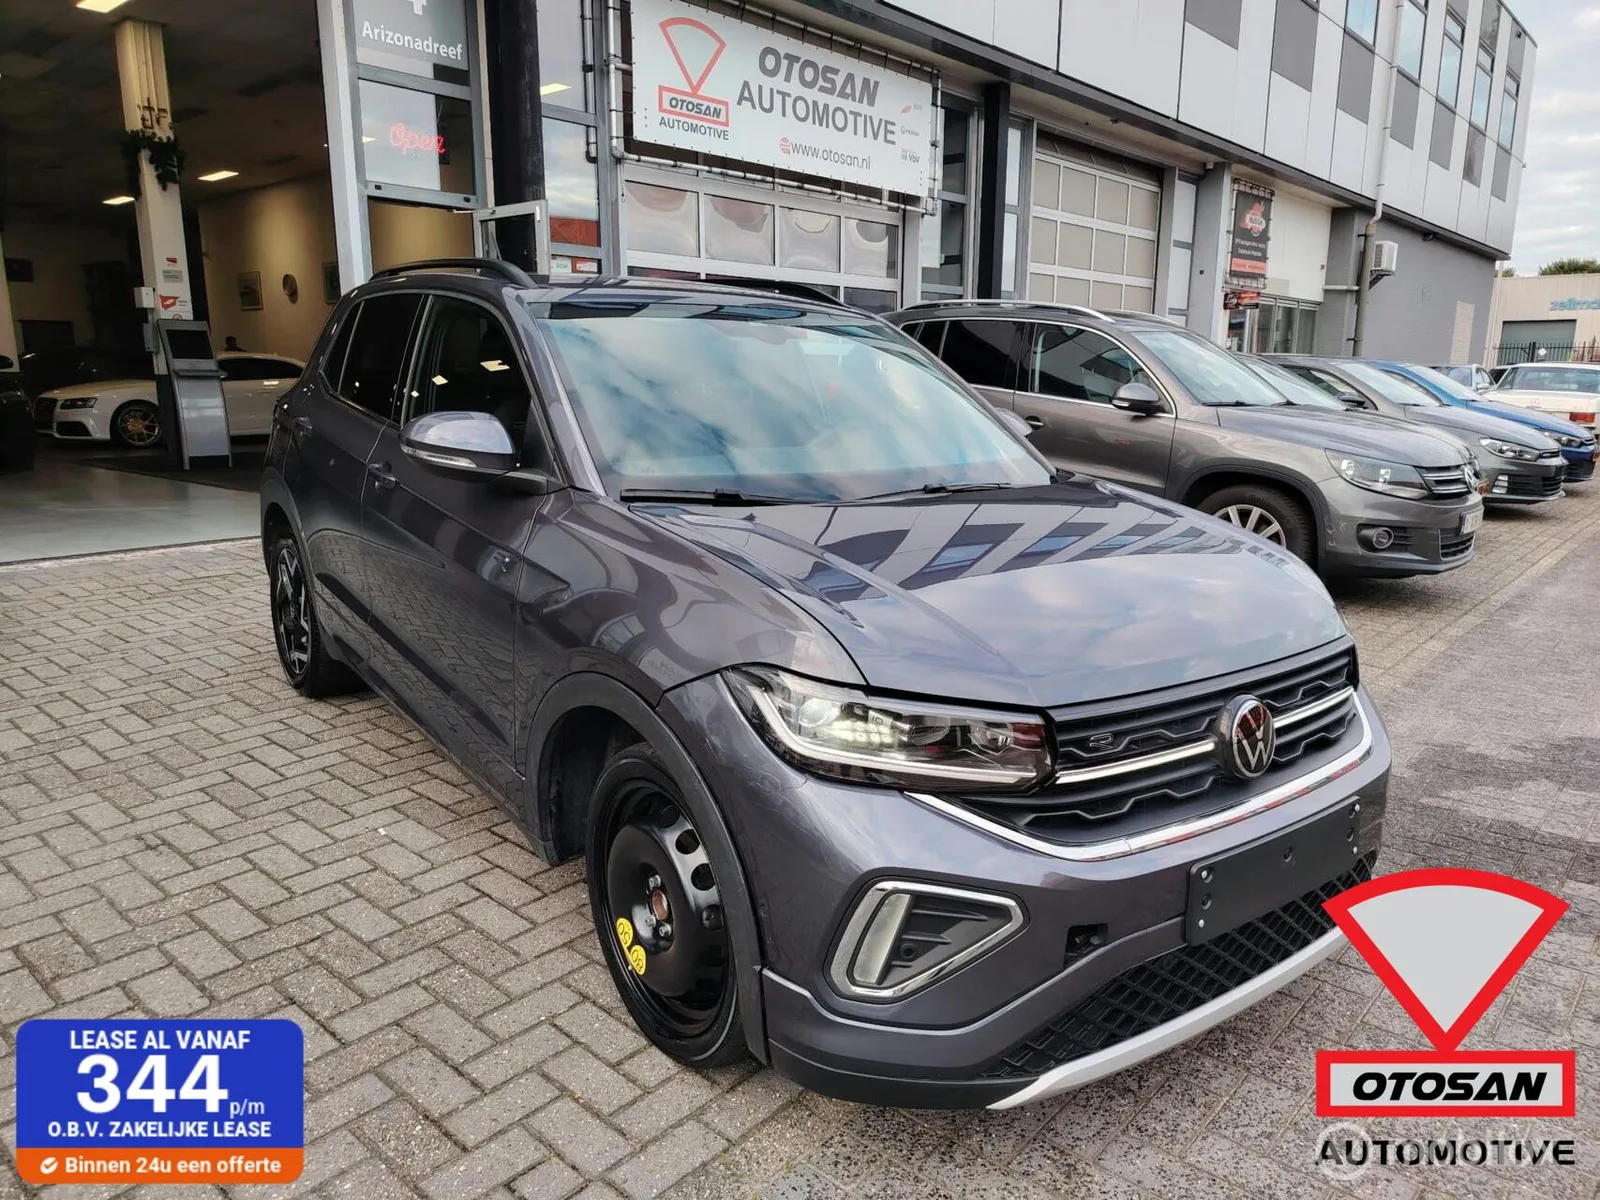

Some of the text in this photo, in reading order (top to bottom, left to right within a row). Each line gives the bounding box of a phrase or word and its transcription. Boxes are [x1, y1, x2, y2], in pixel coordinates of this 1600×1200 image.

[361, 20, 463, 60] Arizonadreef
[758, 46, 880, 107] OTOSAN
[668, 96, 722, 119] OTOSAN
[736, 79, 896, 146] AUTOMOTIVE
[390, 121, 446, 156] Open
[658, 116, 729, 141] AUTOMOTIVE
[791, 140, 871, 170] www.otosan.nl
